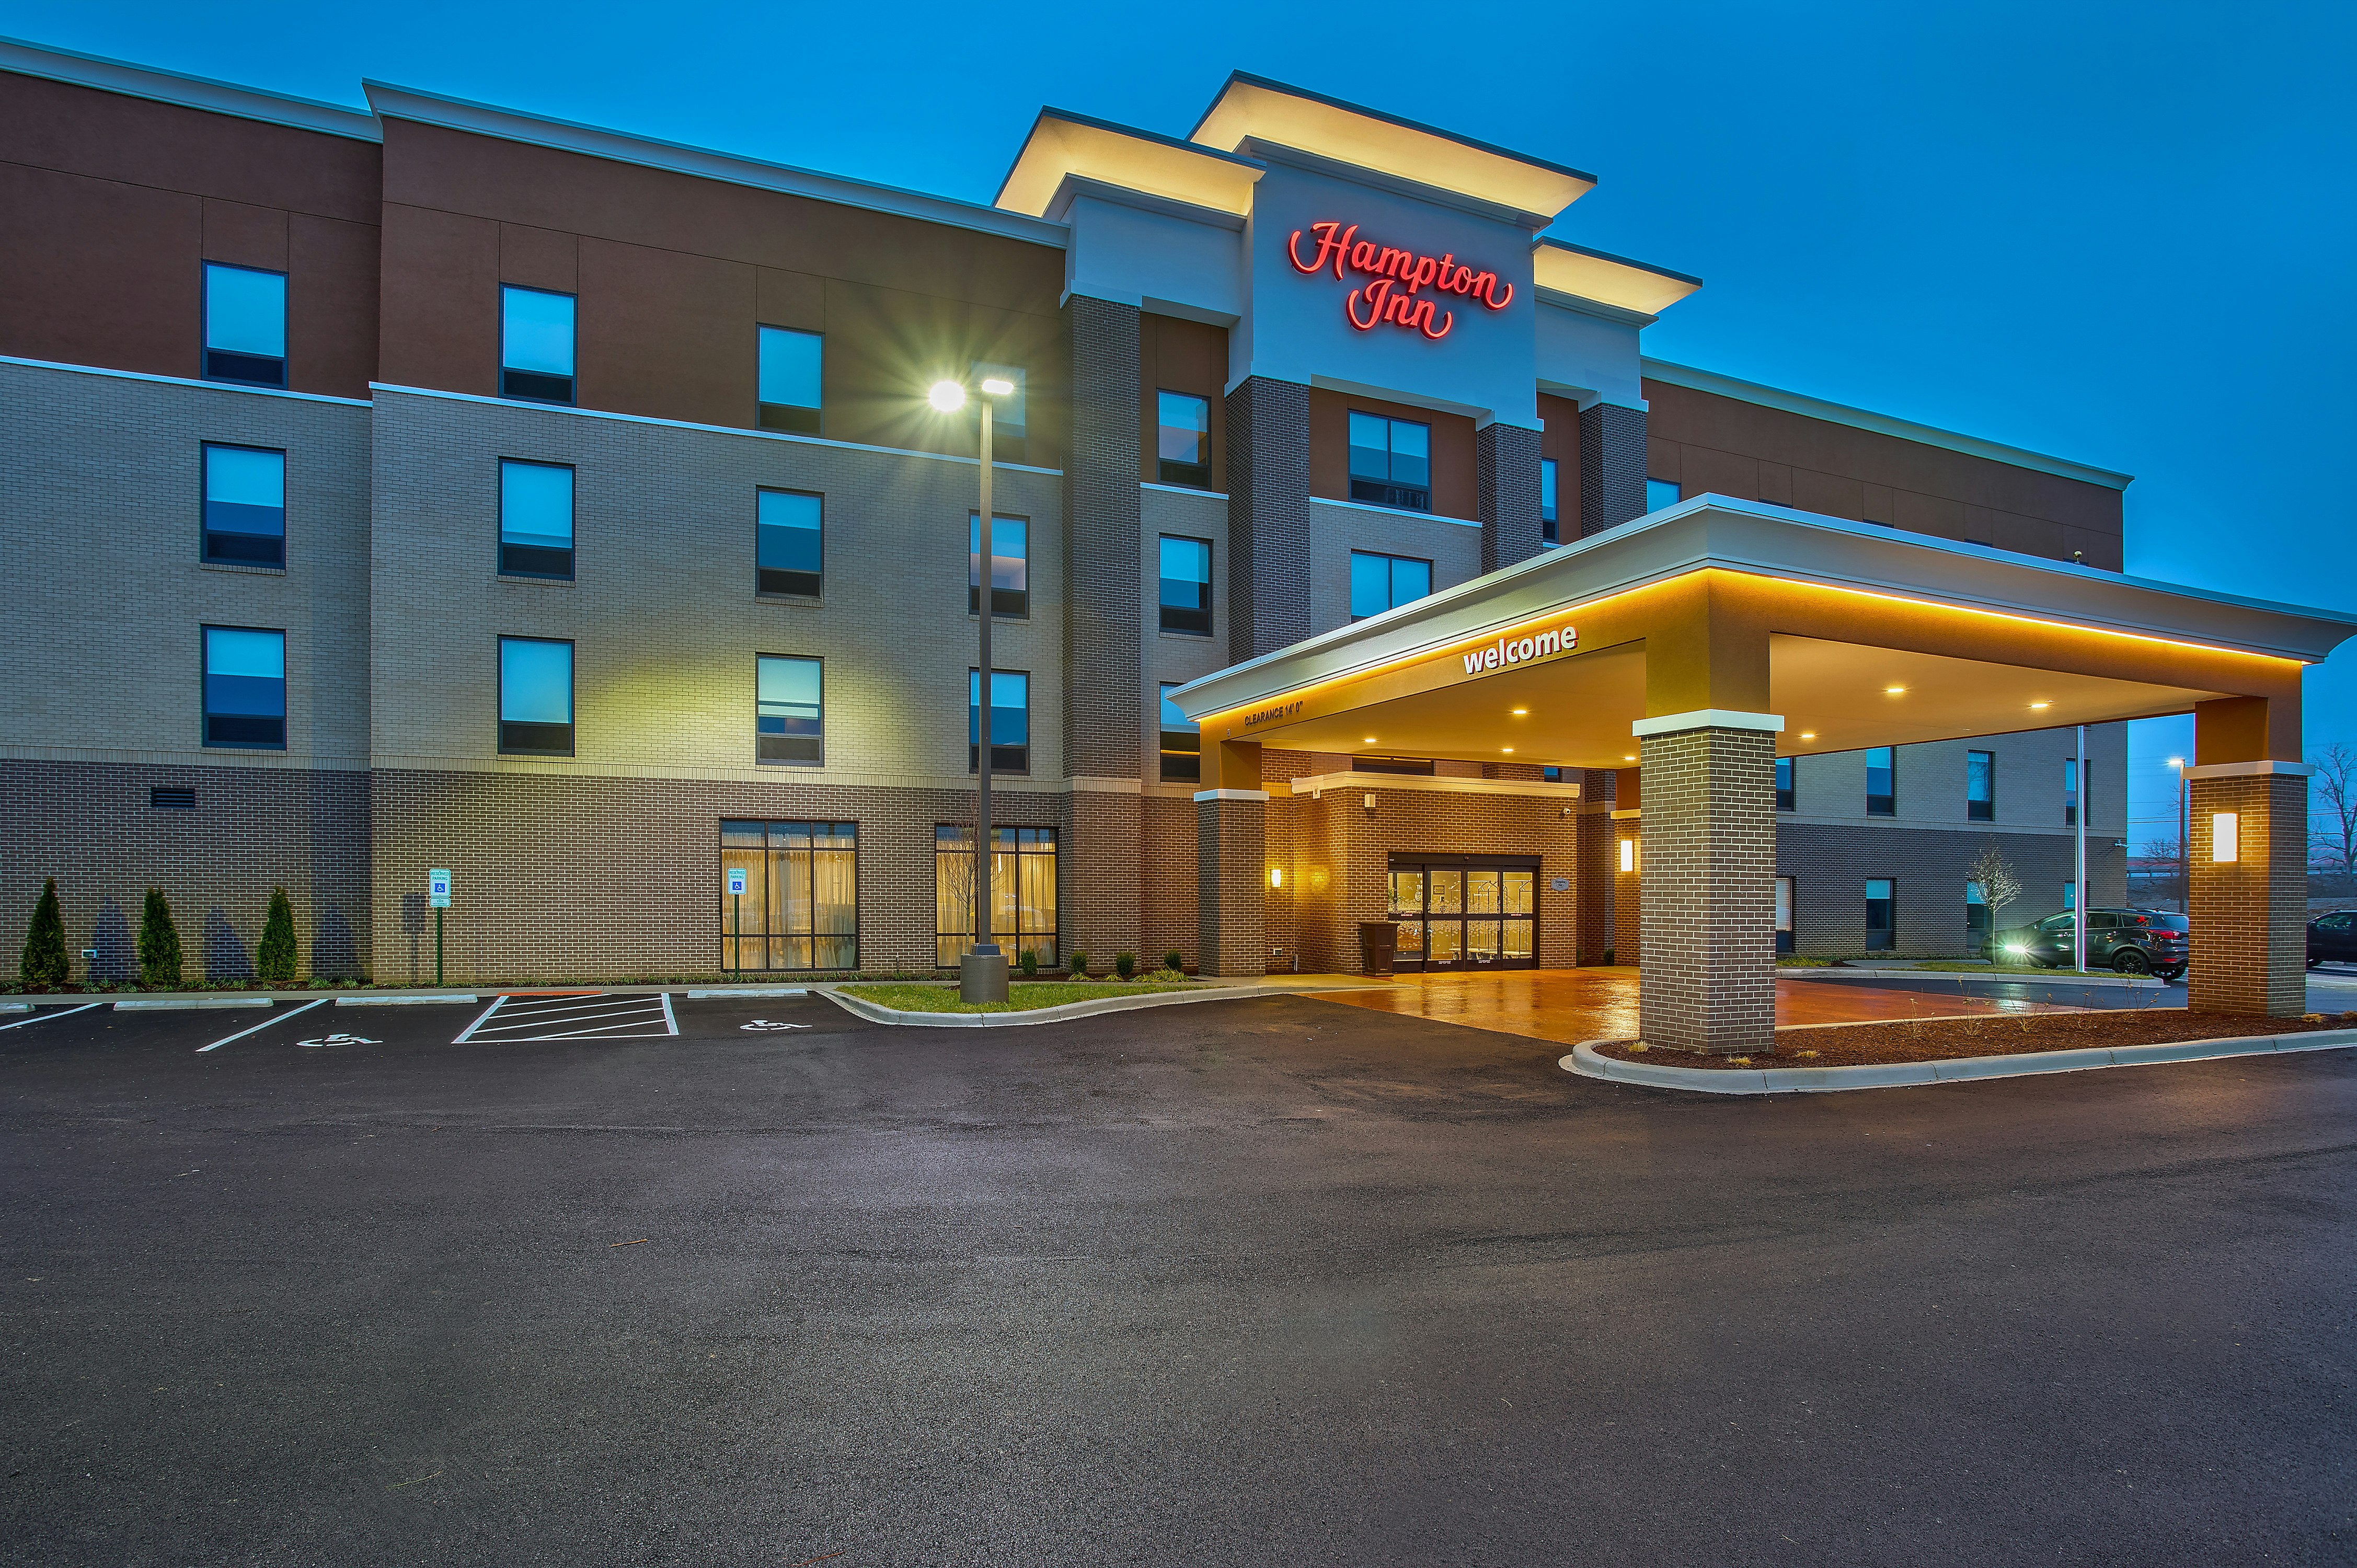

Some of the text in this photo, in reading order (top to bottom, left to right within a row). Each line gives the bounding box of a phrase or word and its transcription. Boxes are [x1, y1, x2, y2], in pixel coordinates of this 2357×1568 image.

[1288, 222, 1513, 310] Hampton
[1346, 279, 1452, 340] Inn
[1463, 626, 1579, 675] welcome
[1245, 706, 1283, 726] CLEARANCE
